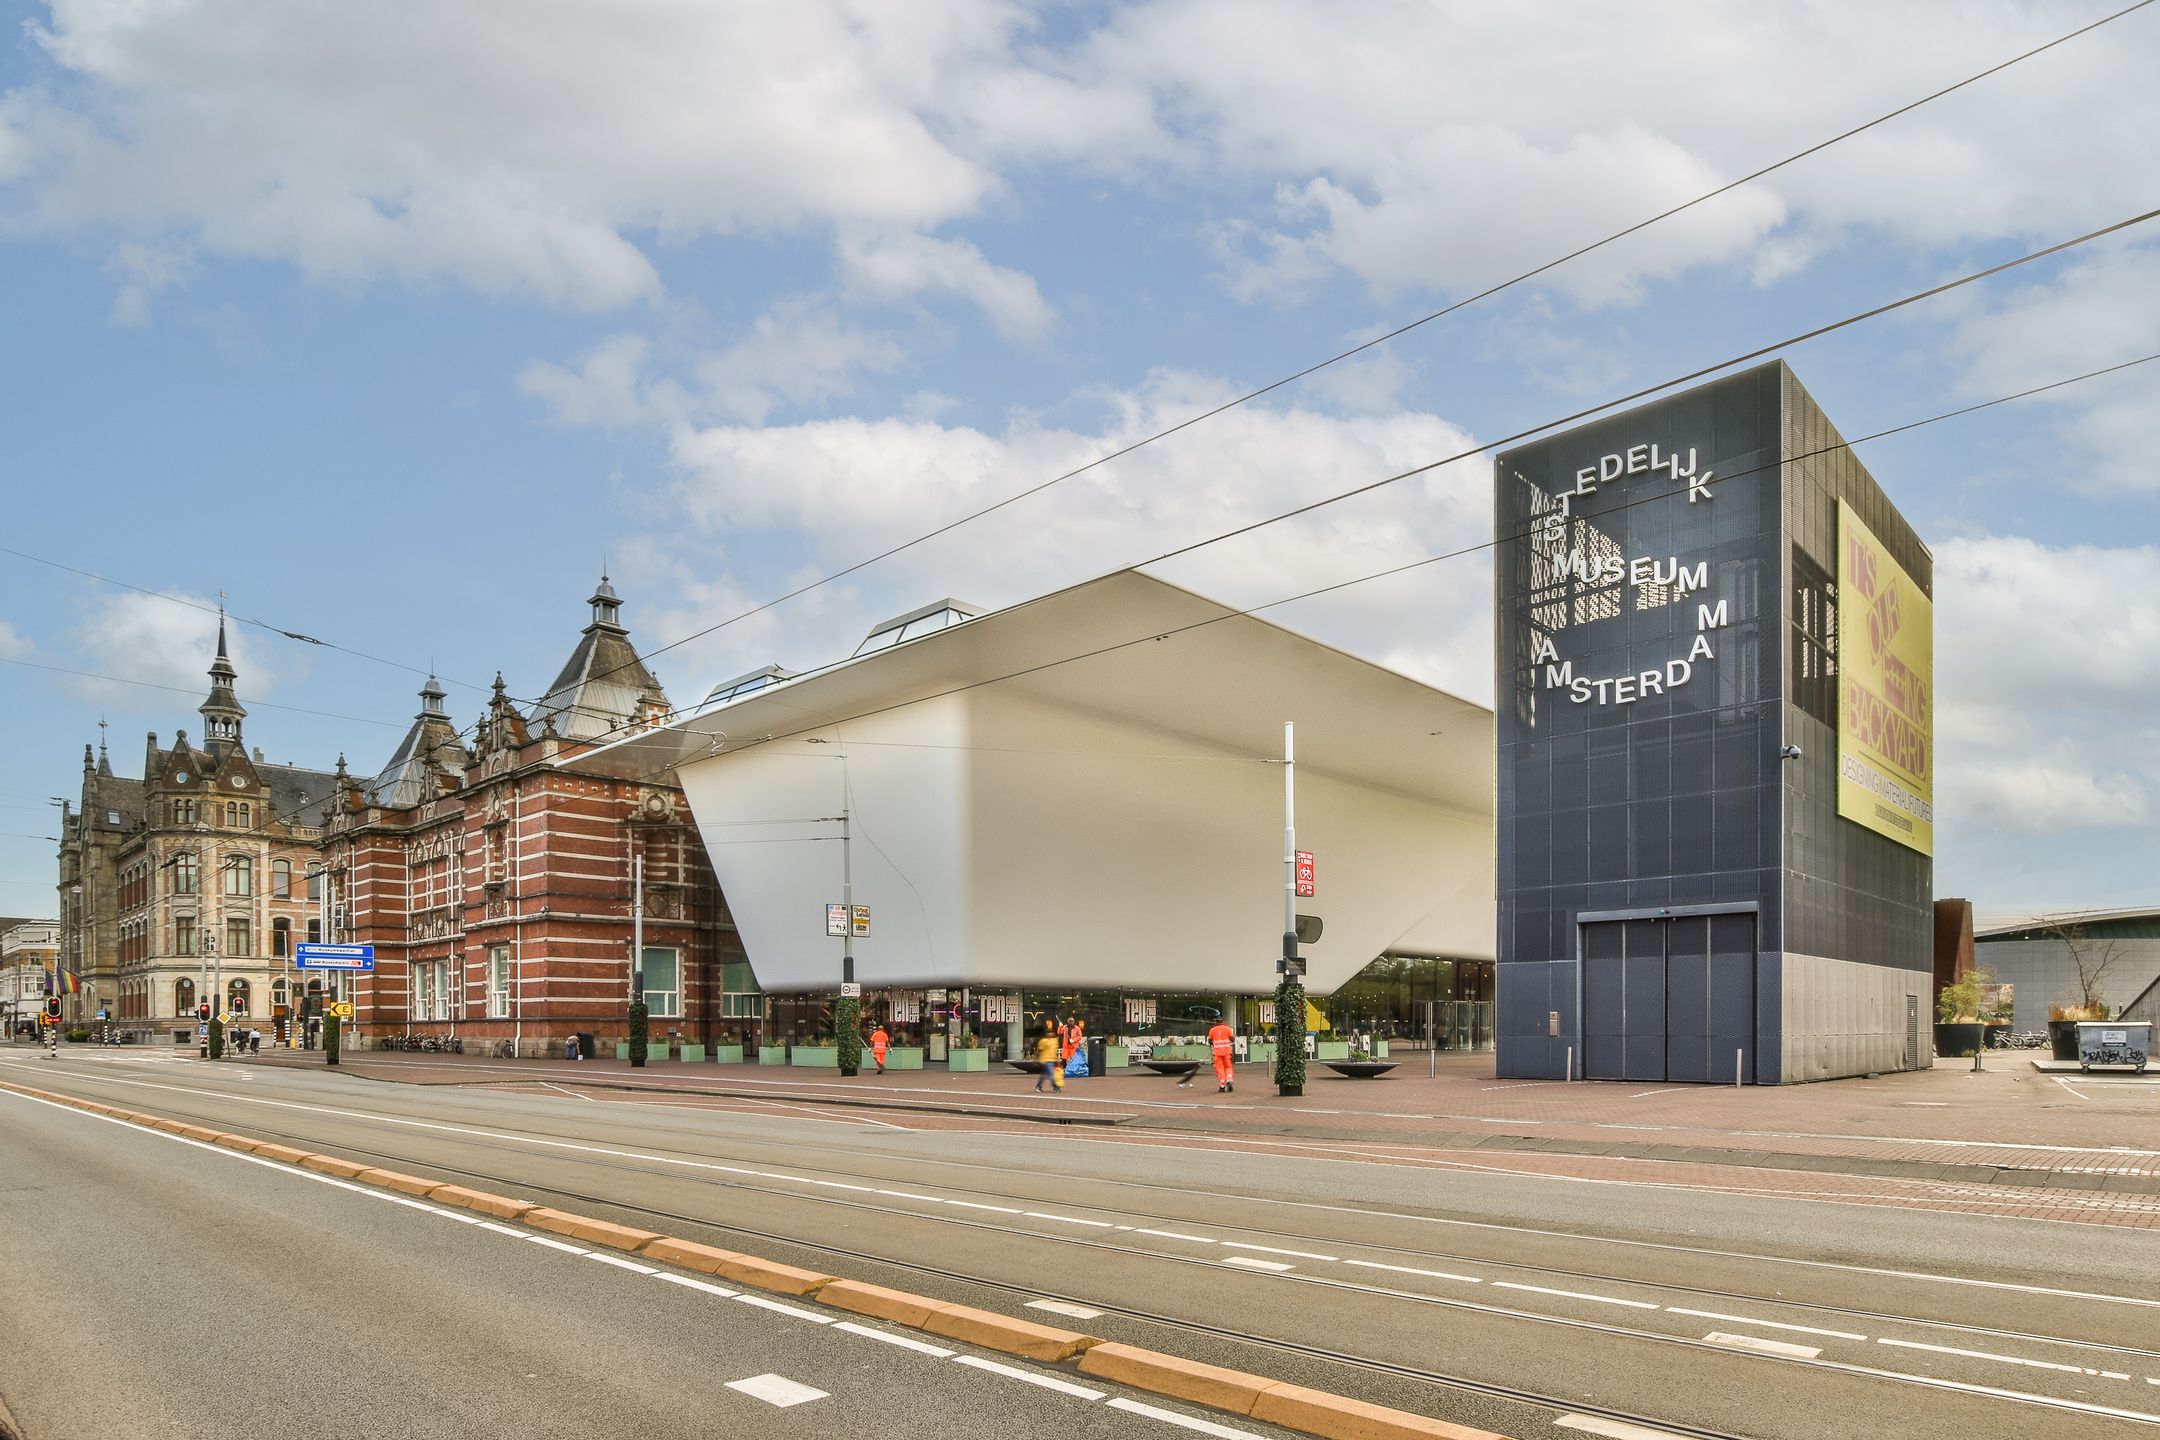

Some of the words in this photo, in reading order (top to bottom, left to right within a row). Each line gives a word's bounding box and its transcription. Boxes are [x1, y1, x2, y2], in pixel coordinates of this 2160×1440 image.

[1543, 443, 1714, 541] STEDELIJK
[1552, 549, 1708, 594] MUSEUM
[1848, 534, 1877, 602] IT'S
[1536, 598, 1728, 706] AMSTERDAM
[1868, 582, 1900, 661] OUR
[1848, 680, 1927, 781] BACKYARD
[1842, 756, 1879, 794] DESIGNING
[1880, 778, 1909, 809] MATERIAL
[1909, 793, 1932, 821] FUTURES
